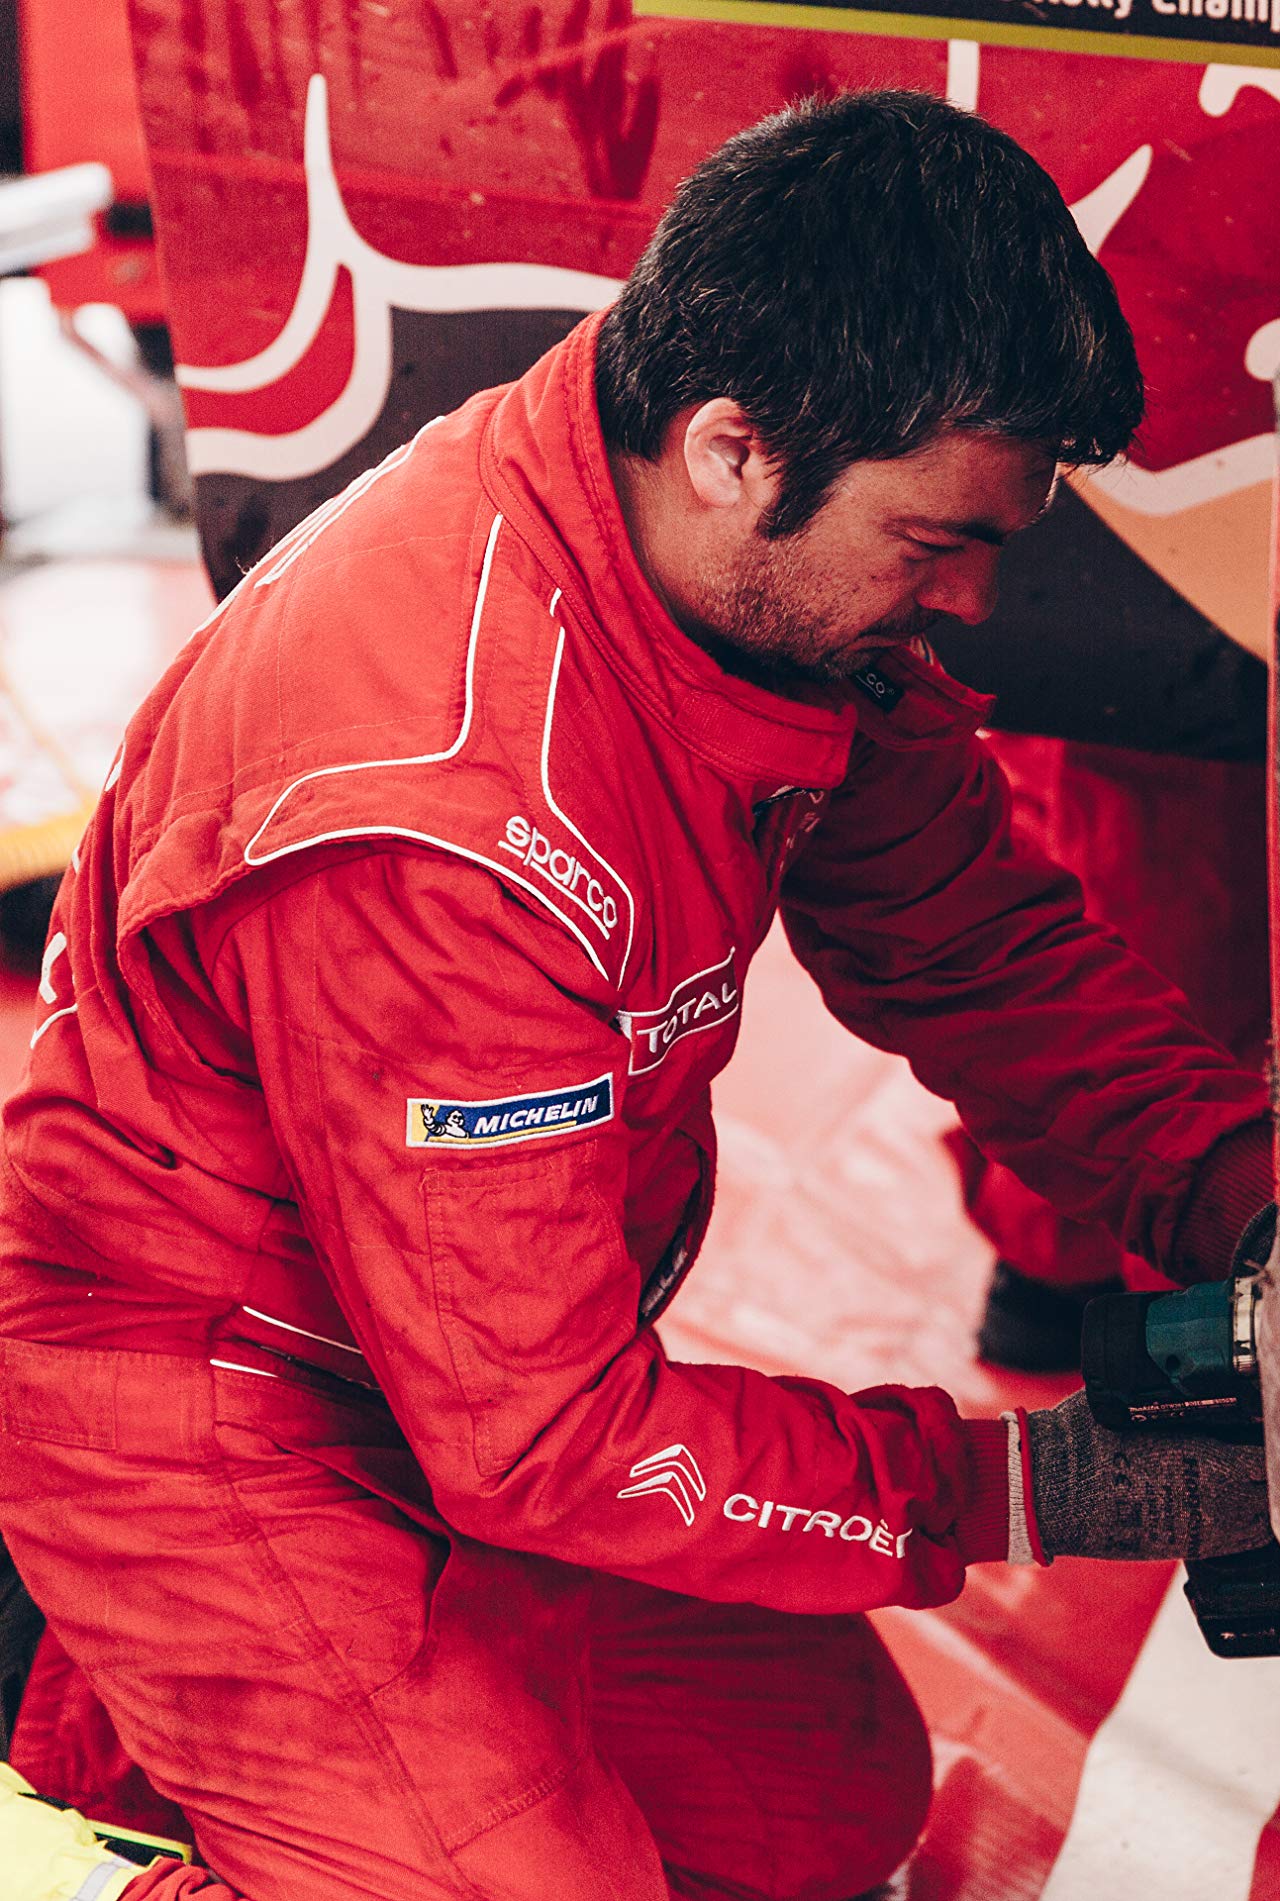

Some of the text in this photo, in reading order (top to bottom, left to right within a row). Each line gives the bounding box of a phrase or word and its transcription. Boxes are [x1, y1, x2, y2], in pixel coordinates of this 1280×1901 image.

[505, 815, 618, 929] sparco
[636, 983, 737, 1053] TOTAL
[473, 1095, 598, 1134] MICHELIN
